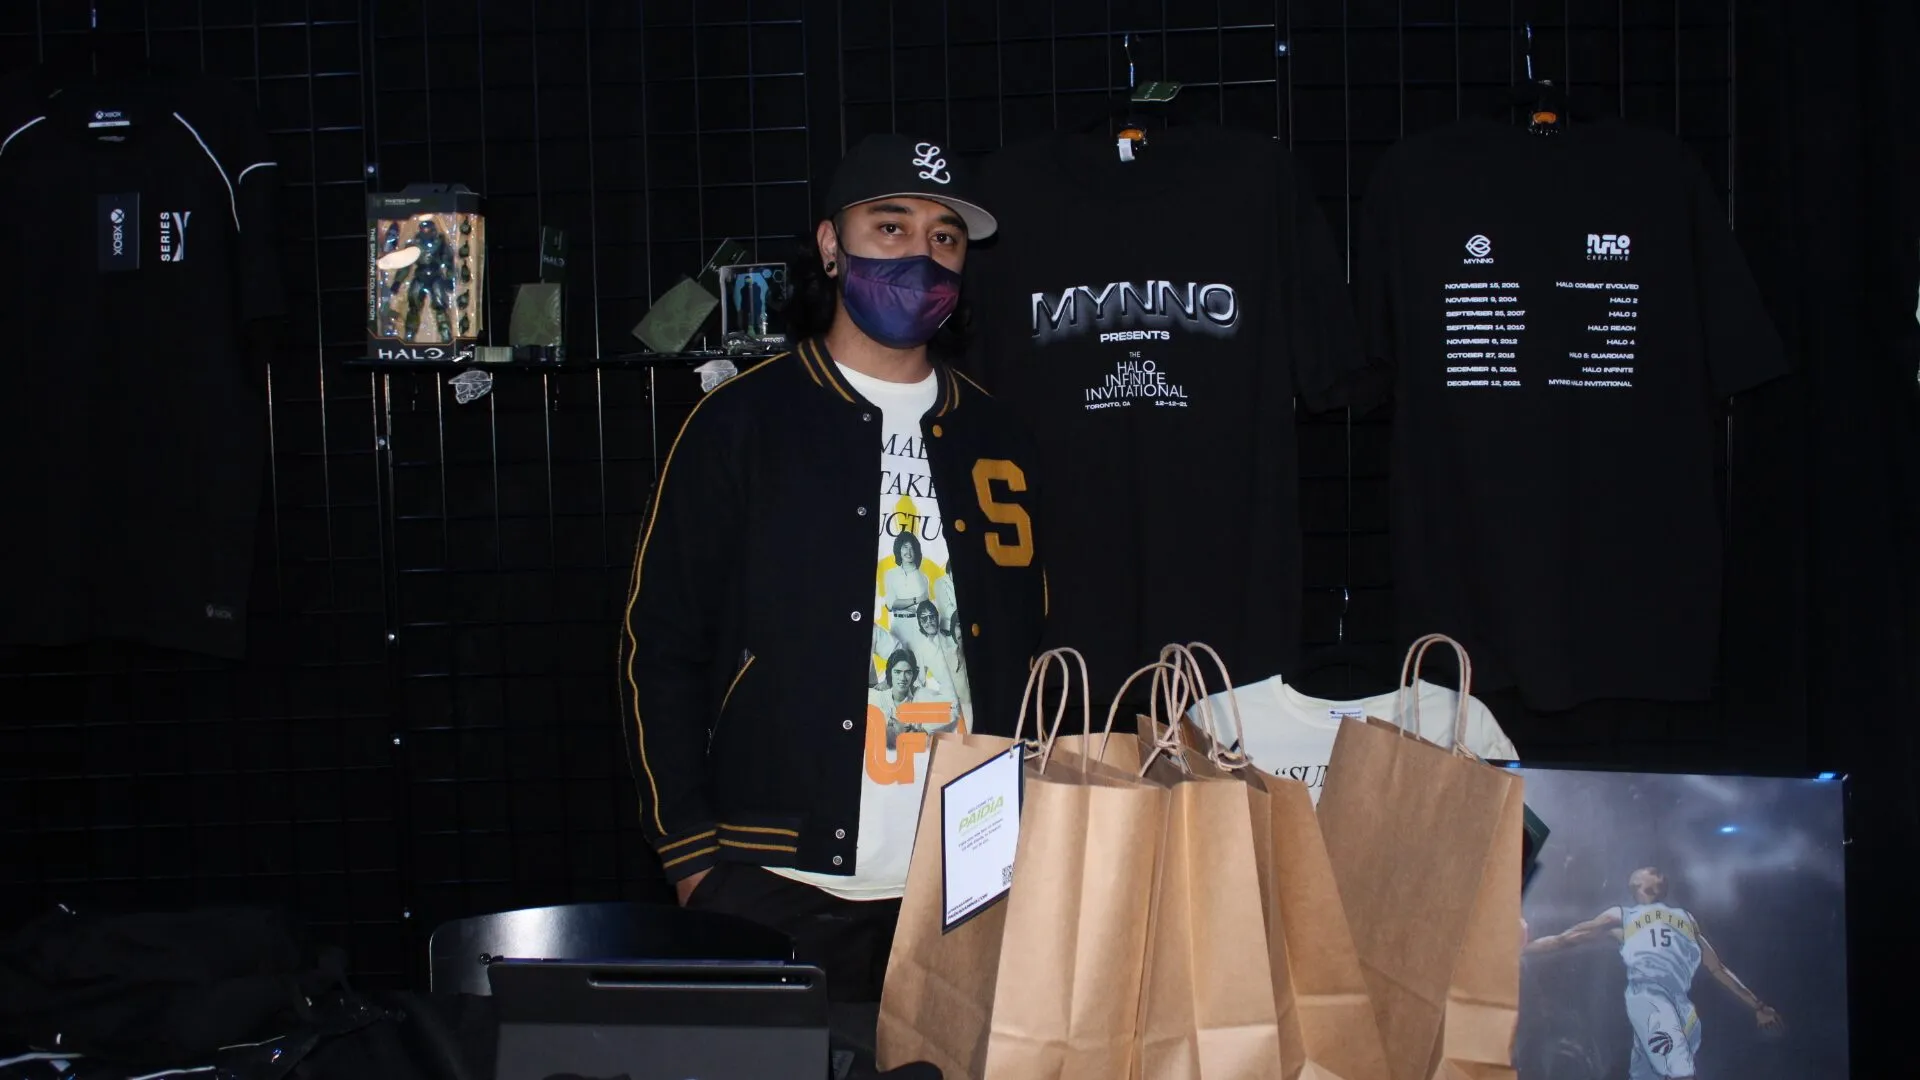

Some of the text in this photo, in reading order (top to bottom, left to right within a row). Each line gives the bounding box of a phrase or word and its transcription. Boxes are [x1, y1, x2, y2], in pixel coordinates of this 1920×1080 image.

[112, 225, 123, 256] XBOX
[159, 211, 171, 263] SERIES
[1444, 282, 1488, 290] NOVEMBER
[1445, 296, 1489, 304] NOVEMBER
[1031, 280, 1240, 339] MYNNO
[1445, 310, 1493, 318] SEPTEMBER
[1446, 324, 1493, 332] SEPTEMBER
[1099, 330, 1171, 343] PRESENTS
[1446, 338, 1490, 346] NOVEMBER
[1606, 338, 1628, 346] HALO
[378, 347, 445, 361] HALO
[1590, 352, 1635, 360] GUARDIANS
[1116, 359, 1156, 374] HALO
[1105, 371, 1167, 388] INFINITE
[1584, 380, 1633, 388] INVITATIONAL
[1085, 384, 1189, 401] INVITATIONAL
[1084, 401, 1121, 411] TORONTO,
[971, 457, 1035, 568] S
[1634, 910, 1685, 929] NORTH
[1649, 928, 1673, 948] 15
